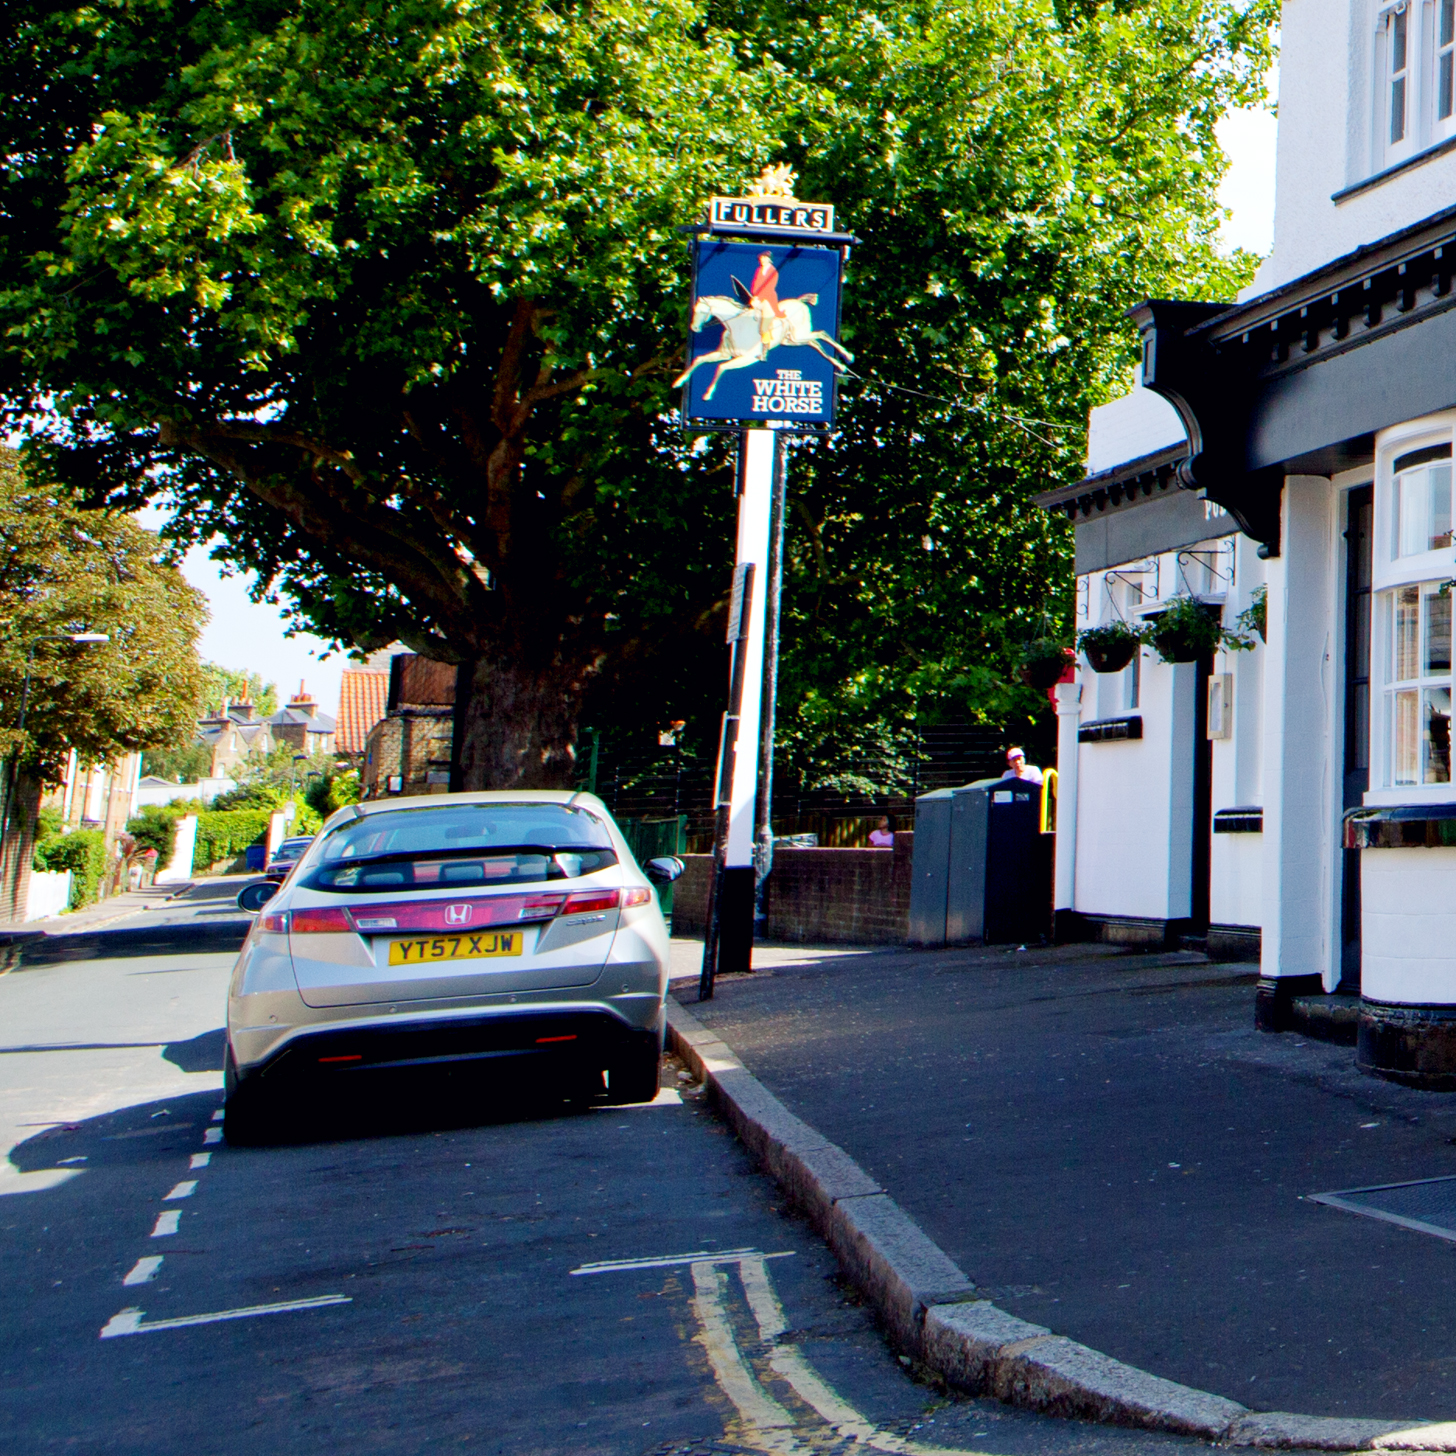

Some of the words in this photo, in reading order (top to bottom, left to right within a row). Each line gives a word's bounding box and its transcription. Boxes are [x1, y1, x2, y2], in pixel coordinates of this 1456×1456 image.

[718, 202, 825, 228] FULLER'S
[775, 368, 802, 380] THE
[752, 378, 823, 397] WHITE
[752, 395, 823, 414] HORSE
[399, 938, 462, 960] YT57
[468, 934, 514, 955] XJW
